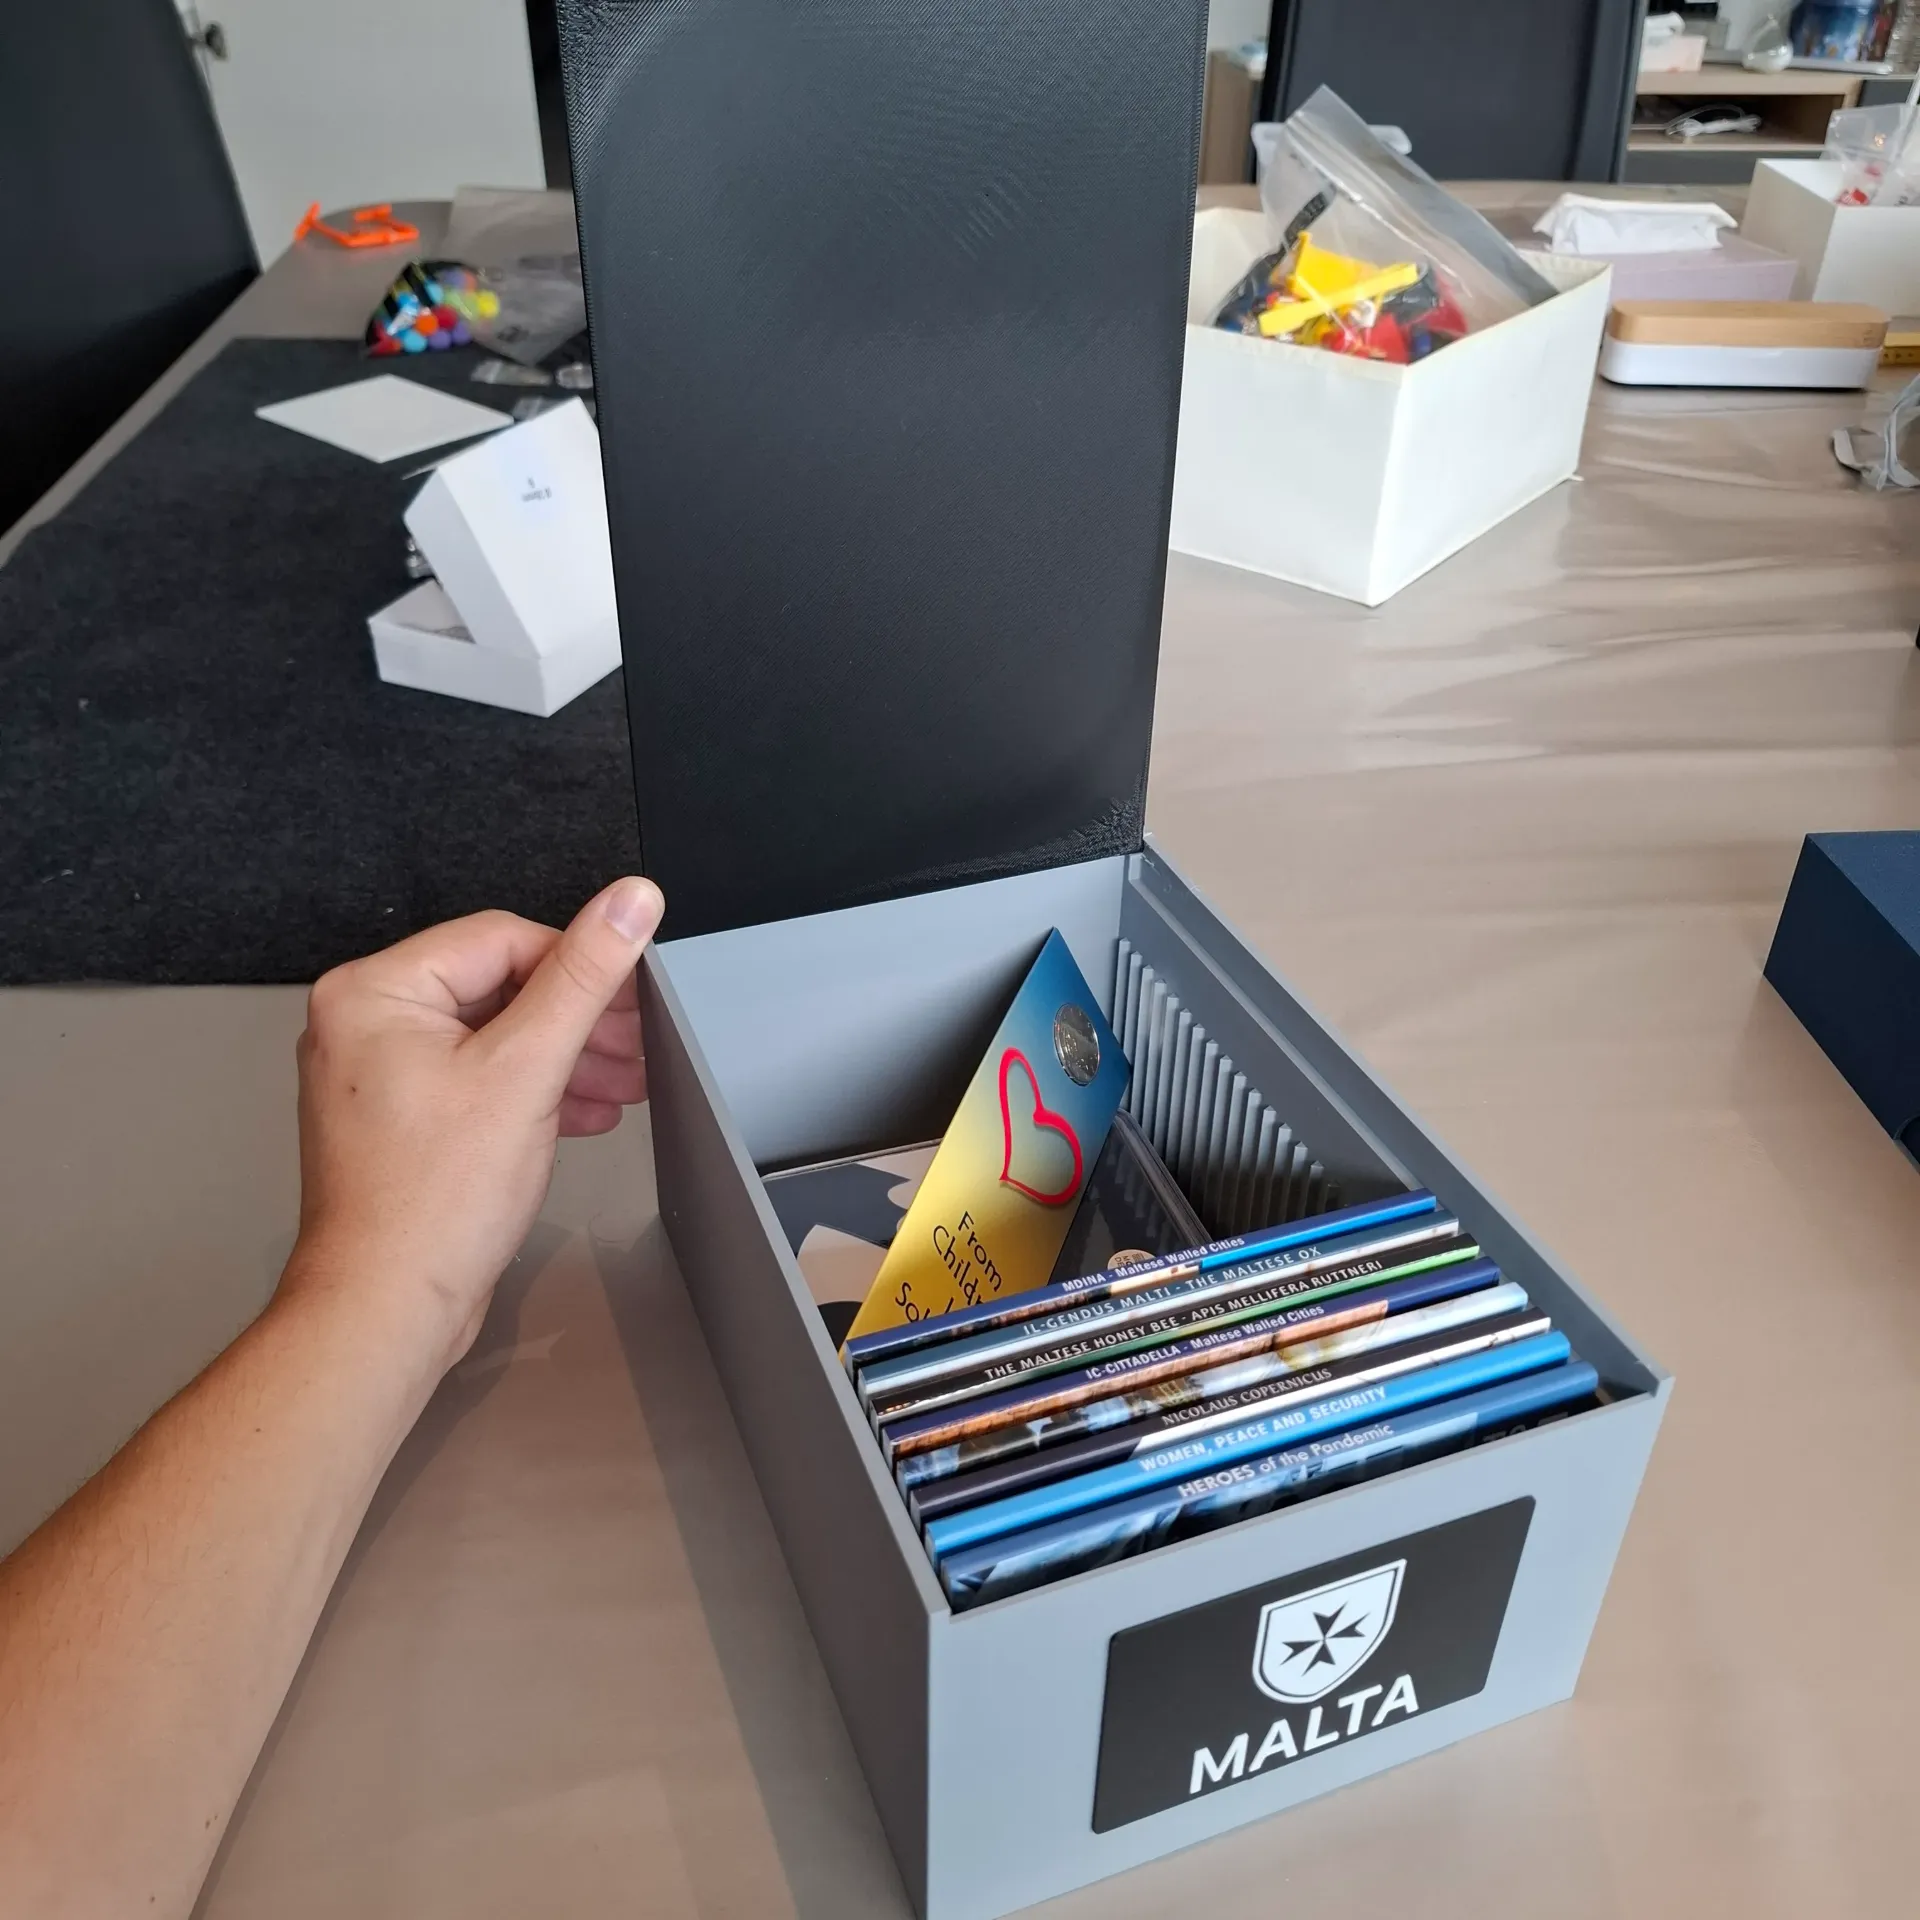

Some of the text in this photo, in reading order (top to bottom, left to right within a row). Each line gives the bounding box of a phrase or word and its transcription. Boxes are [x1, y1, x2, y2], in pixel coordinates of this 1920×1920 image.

[958, 1211, 1002, 1292] From
[1023, 1300, 1114, 1335] IL-GENDUS
[1120, 1285, 1171, 1308] MALTI
[1185, 1272, 1216, 1290] THE
[1221, 1252, 1292, 1280] MALTESE
[1298, 1244, 1321, 1261] OX
[1062, 1272, 1105, 1292] MDINA
[1115, 1255, 1163, 1277] Maltese
[1164, 1243, 1207, 1264] Walled
[1209, 1235, 1244, 1253] Cities
[984, 1362, 1015, 1380] THE
[1018, 1341, 1092, 1370] MALTESE
[1094, 1325, 1146, 1348] HONEY
[1149, 1316, 1179, 1333] BEE
[1189, 1302, 1224, 1321] APIS
[1228, 1280, 1309, 1310] MELLIFERA
[1311, 1259, 1383, 1288] RUTTNERI
[1086, 1343, 1181, 1379] IC-CITTADELLA
[1190, 1327, 1240, 1349] Maltese
[1242, 1314, 1285, 1336] Walled
[1287, 1303, 1324, 1323] Cities
[1140, 1387, 1386, 1472] WOMEN, PEACE AND SECURITY
[1161, 1368, 1331, 1426] NICOLAUS COPERNICUS
[1178, 1422, 1393, 1498] HEROES of the Pandemic
[1189, 1673, 1419, 1794] MALTA
